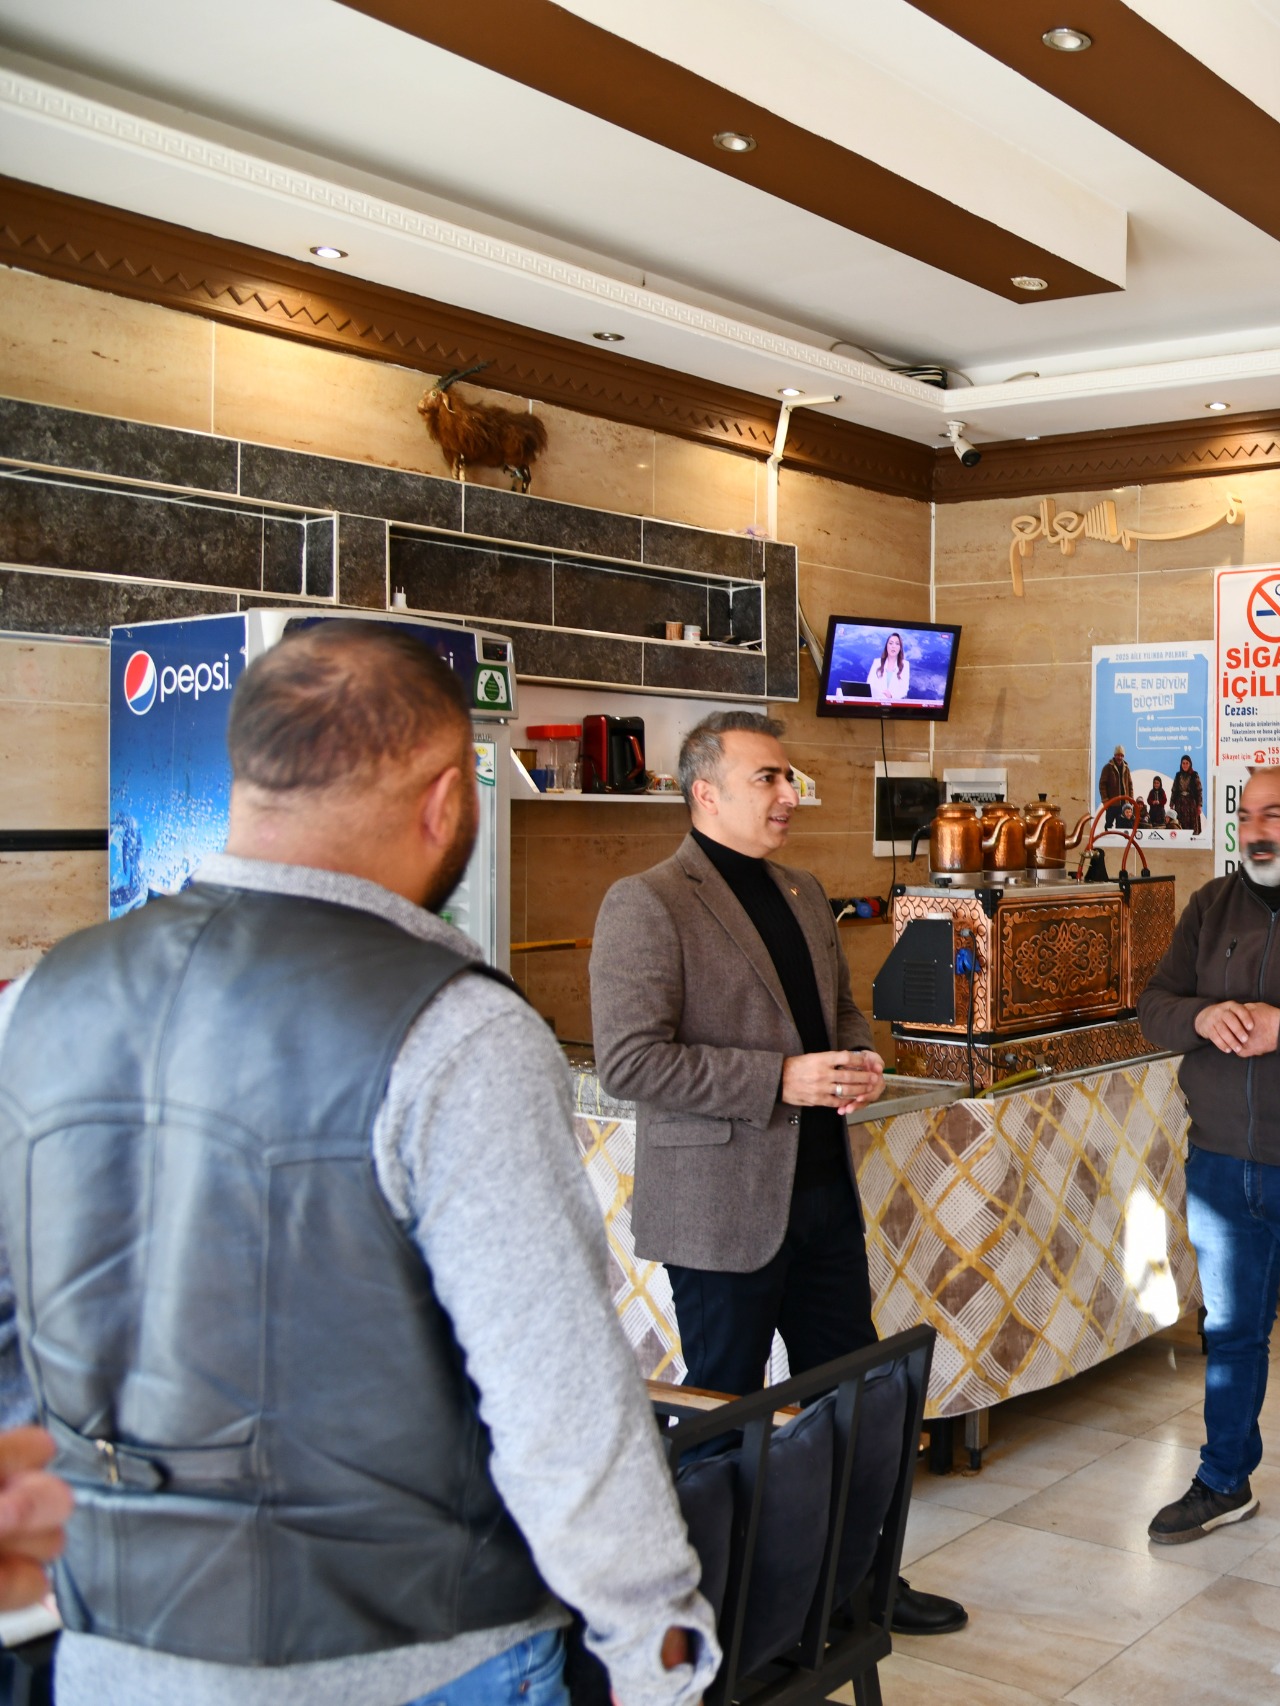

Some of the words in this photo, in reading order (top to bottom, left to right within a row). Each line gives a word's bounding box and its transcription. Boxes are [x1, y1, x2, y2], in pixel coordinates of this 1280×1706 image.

[160, 653, 230, 703] pepsi
[1141, 678, 1153, 689] EN
[1156, 676, 1187, 689] BÜYÜK
[1133, 694, 1173, 709] GÜÇTÜR!
[1224, 704, 1258, 716] Cezası:
[1268, 757, 1280, 765] 153
